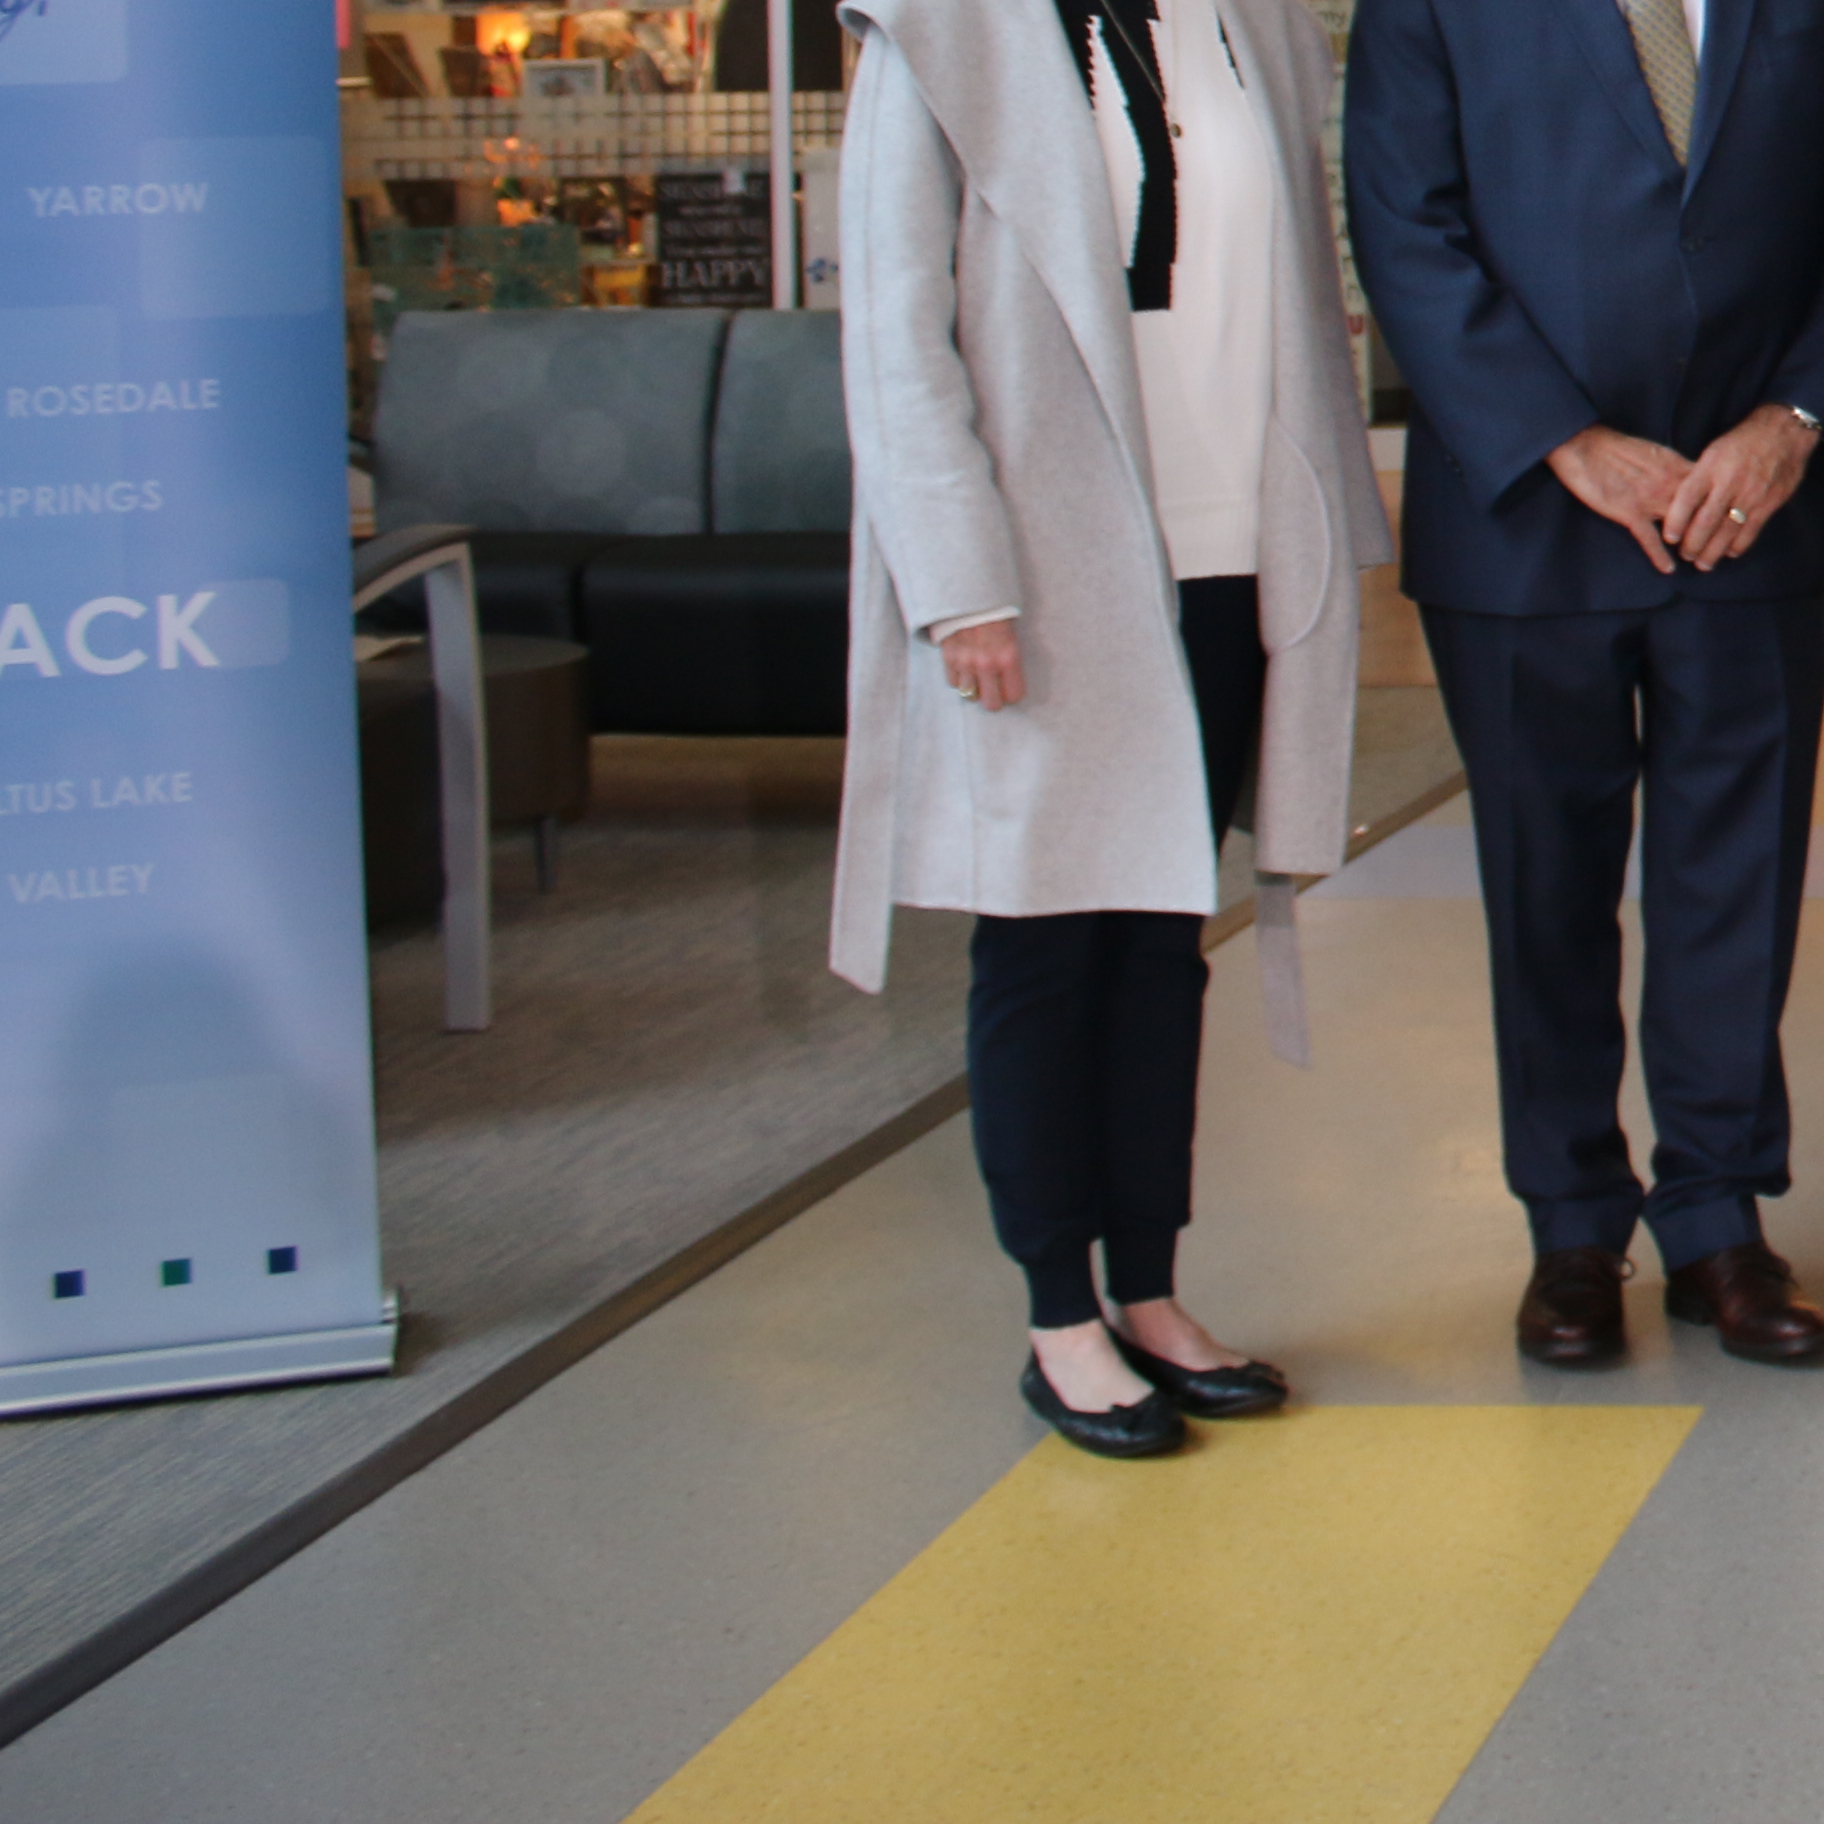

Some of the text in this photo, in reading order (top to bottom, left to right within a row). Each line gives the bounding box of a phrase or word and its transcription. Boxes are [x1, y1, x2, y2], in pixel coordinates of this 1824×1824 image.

[25, 181, 209, 219] YARROW
[6, 378, 221, 419] ROSEDALE
[91, 771, 193, 811] LAKE
[7, 861, 155, 905] VALLEY
